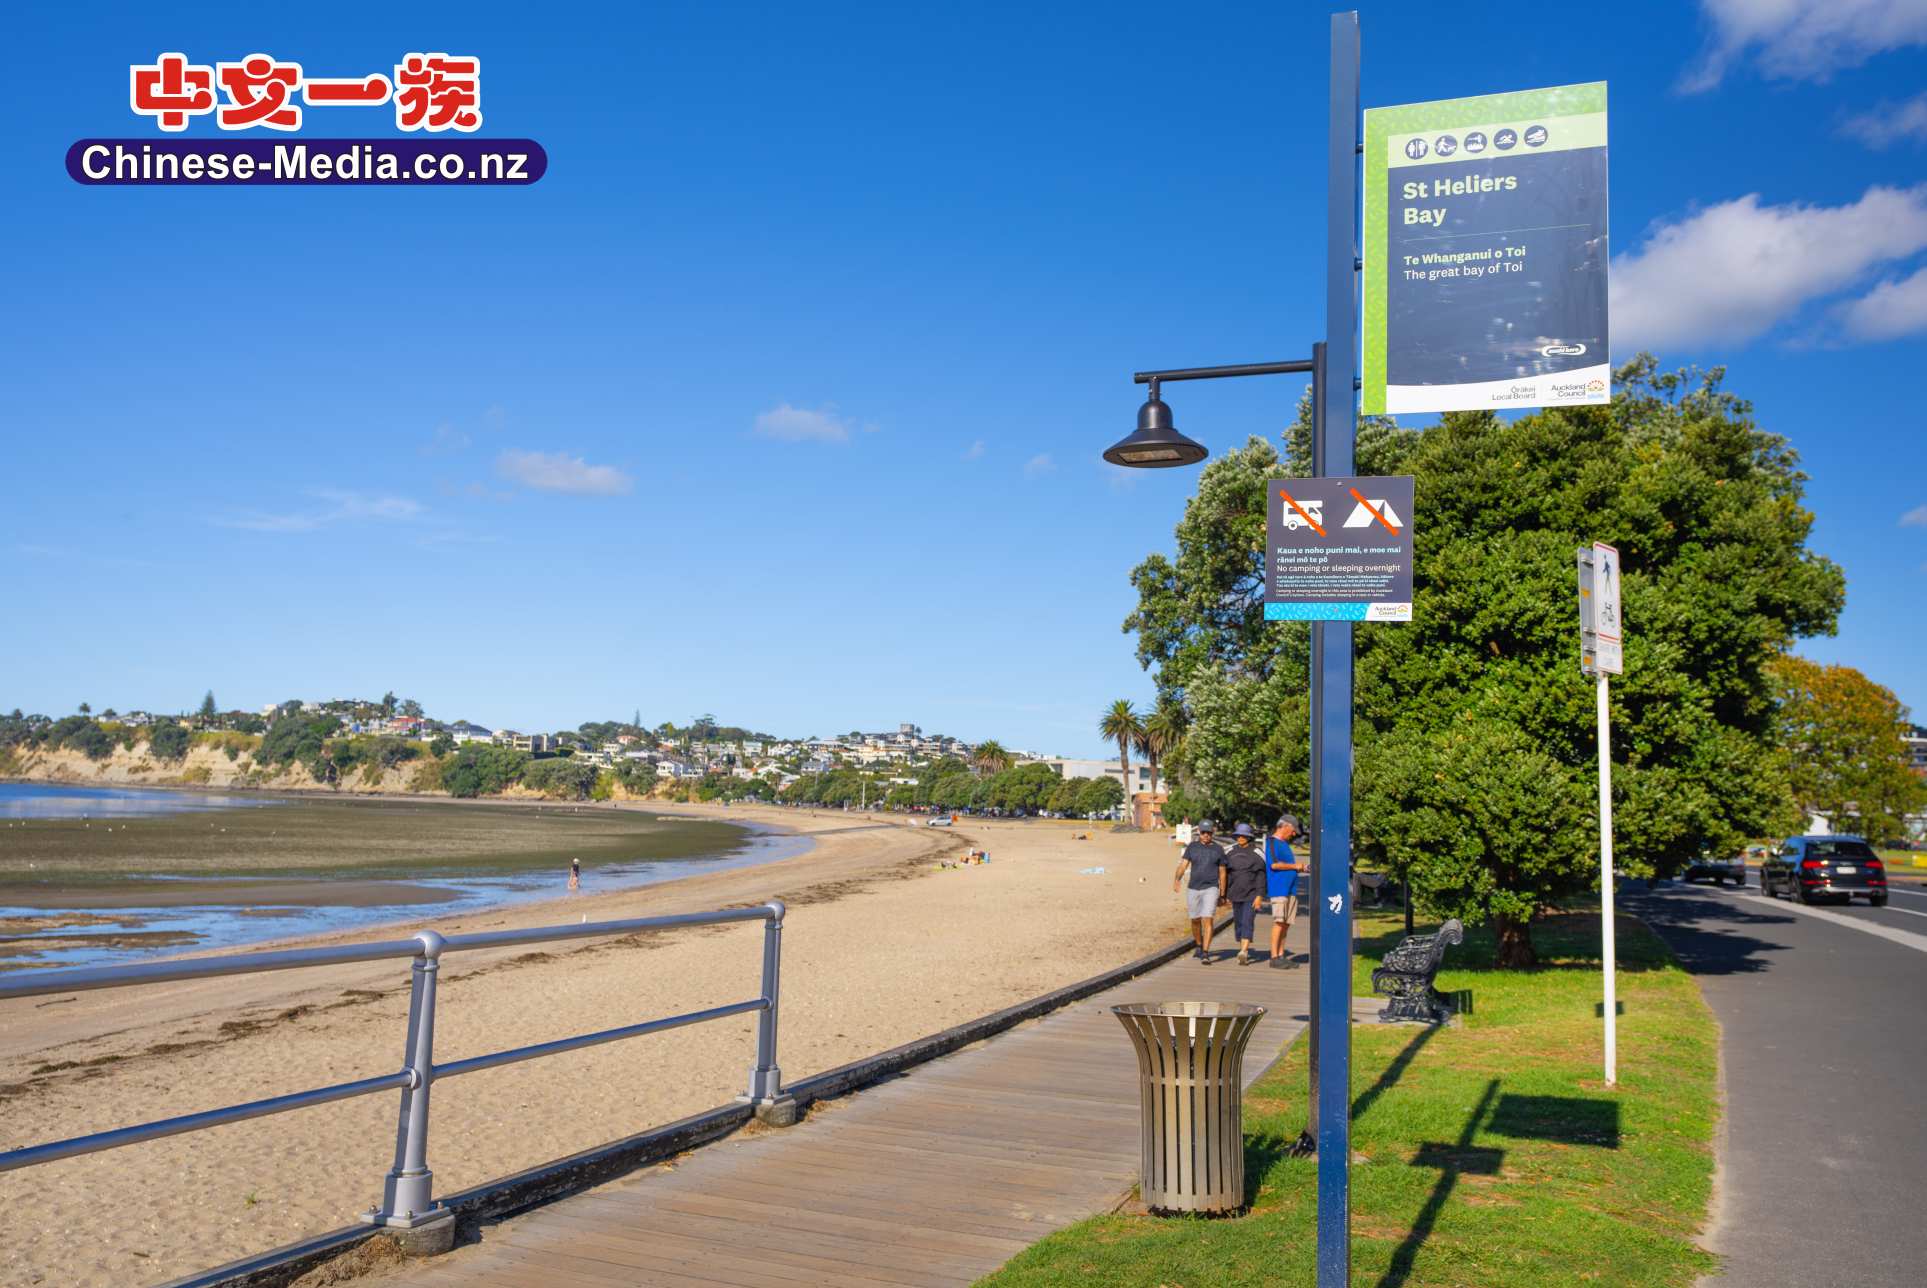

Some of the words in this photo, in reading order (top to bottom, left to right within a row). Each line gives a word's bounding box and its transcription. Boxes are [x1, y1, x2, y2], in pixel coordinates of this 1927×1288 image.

[1403, 182, 1428, 199] St
[1435, 175, 1517, 196] Heliers
[1403, 207, 1447, 227] Bay
[1403, 255, 1420, 266] Te
[1421, 248, 1492, 264] Whanganui
[1495, 249, 1502, 258] o
[1505, 246, 1526, 257] Toi
[1404, 270, 1425, 281] The
[1428, 267, 1460, 281] great
[1463, 264, 1485, 277] bay
[1488, 263, 1501, 273] of
[1504, 262, 1523, 272] Toi
[1551, 383, 1586, 391] Auckland
[1305, 546, 1324, 554] noho
[1326, 546, 1344, 555] puni
[1289, 565, 1320, 573] camping
[1332, 564, 1363, 573] sleeping
[1364, 564, 1401, 573] overnight
